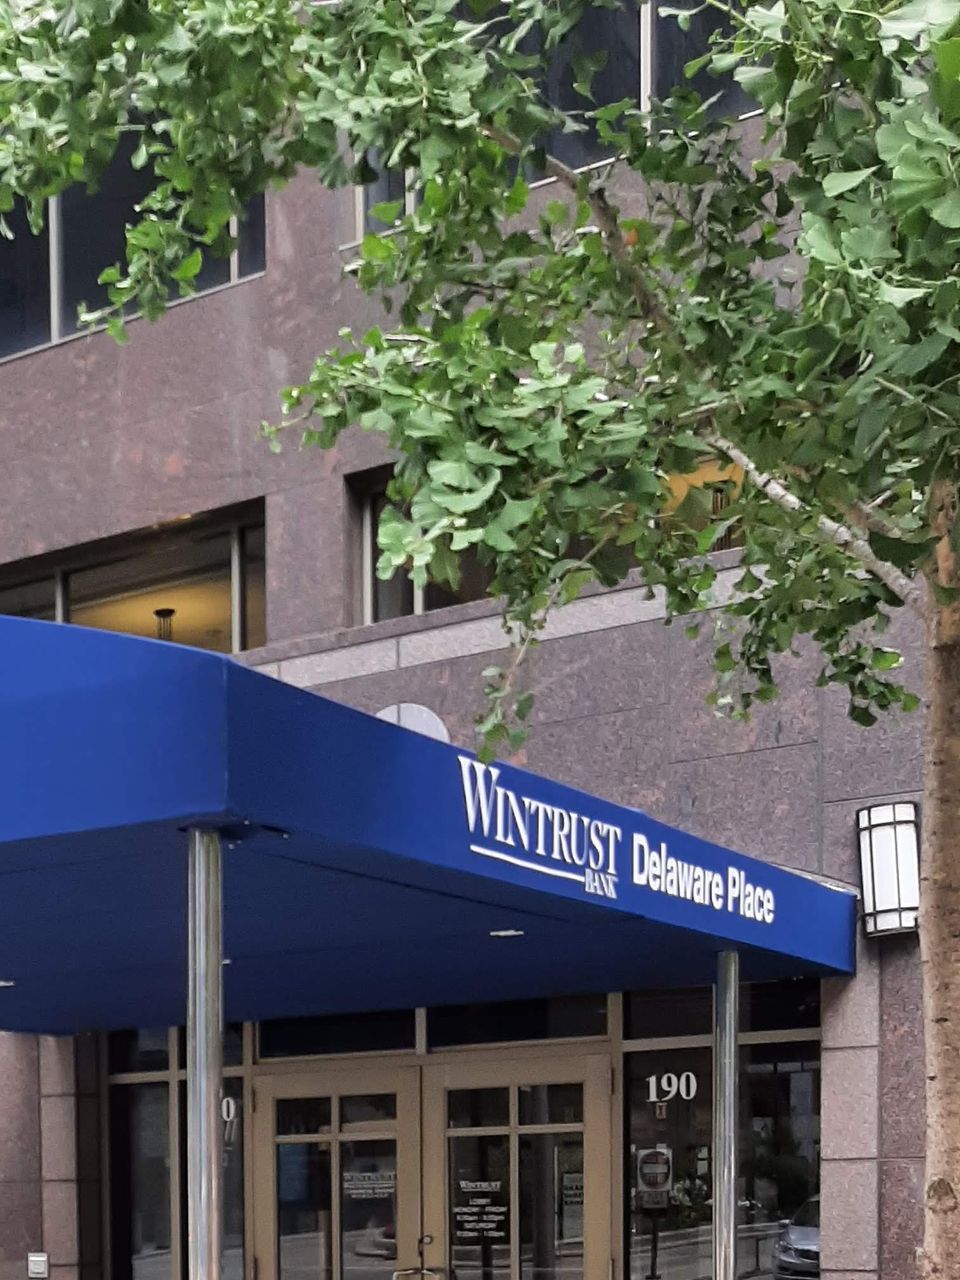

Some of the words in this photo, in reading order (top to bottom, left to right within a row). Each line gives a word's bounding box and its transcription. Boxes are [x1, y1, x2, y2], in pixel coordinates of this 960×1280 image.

[457, 755, 622, 876] WINTRUST
[585, 867, 619, 899] BANK
[632, 832, 724, 911] Delaware
[727, 866, 776, 924] Place
[645, 1071, 697, 1103] 190
